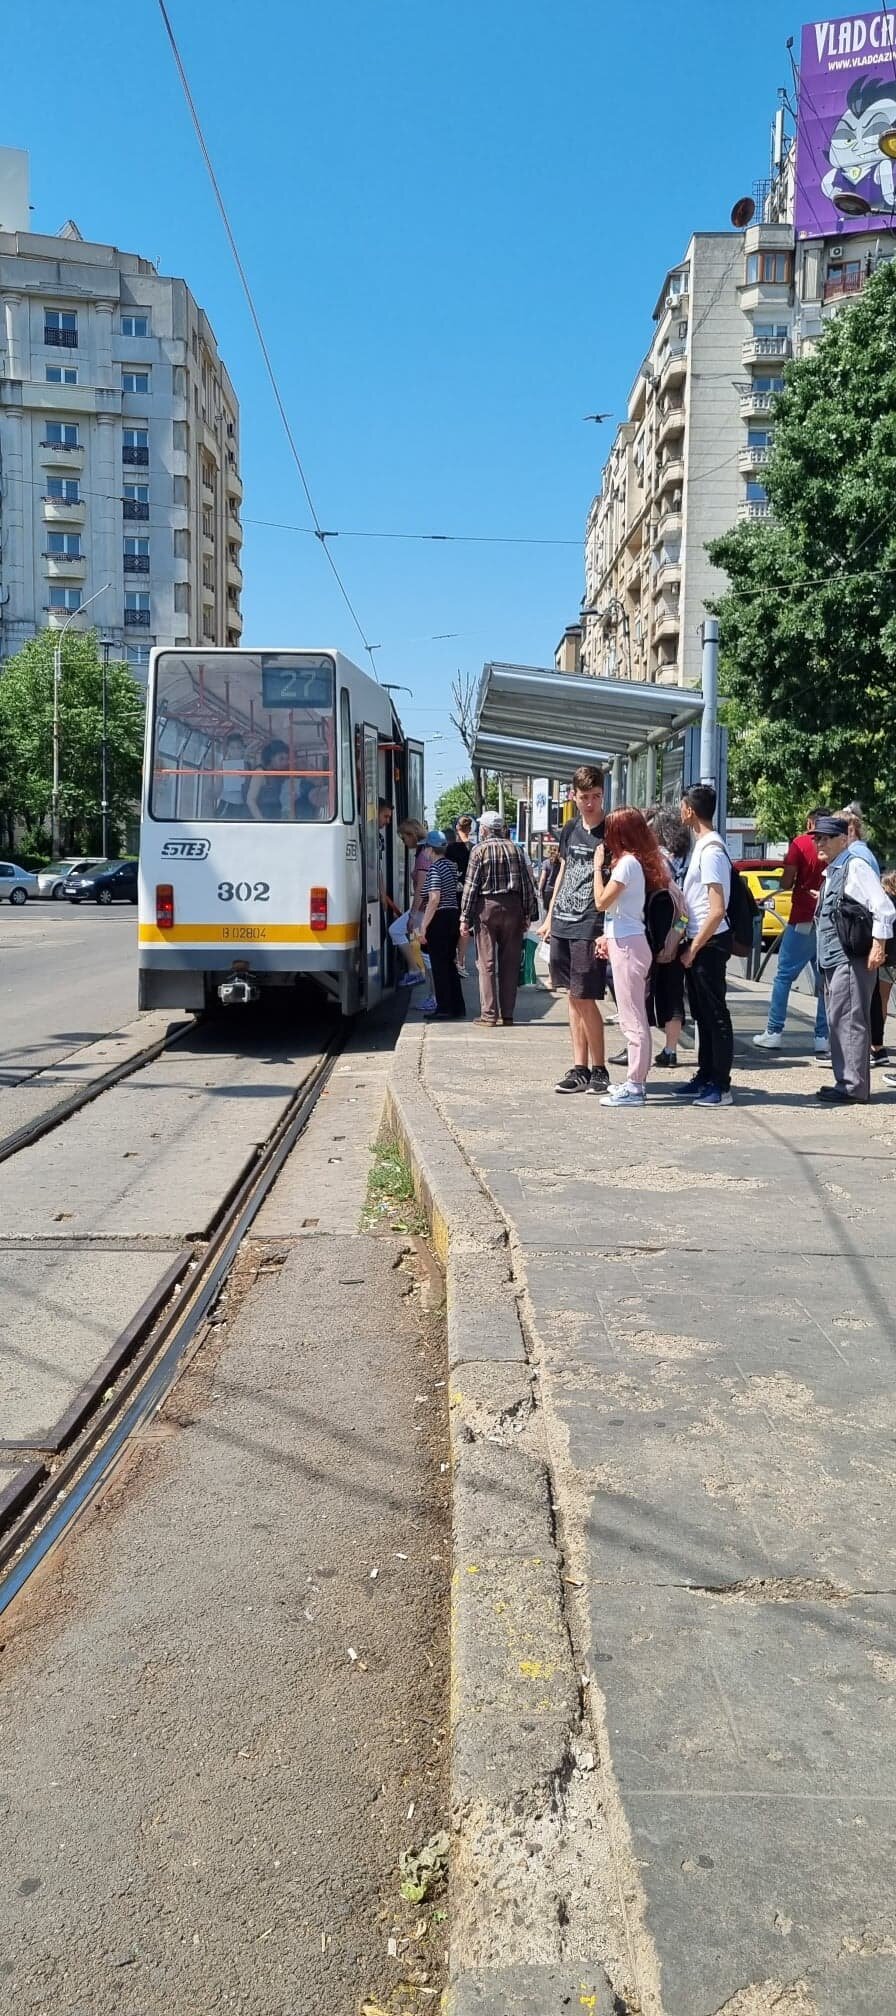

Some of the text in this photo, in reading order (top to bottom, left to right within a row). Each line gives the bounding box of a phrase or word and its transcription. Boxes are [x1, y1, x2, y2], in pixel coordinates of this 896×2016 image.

[814, 14, 896, 63] VLAD CA
[280, 670, 316, 697] 27
[217, 881, 270, 902] 302
[232, 927, 267, 939] 02804
